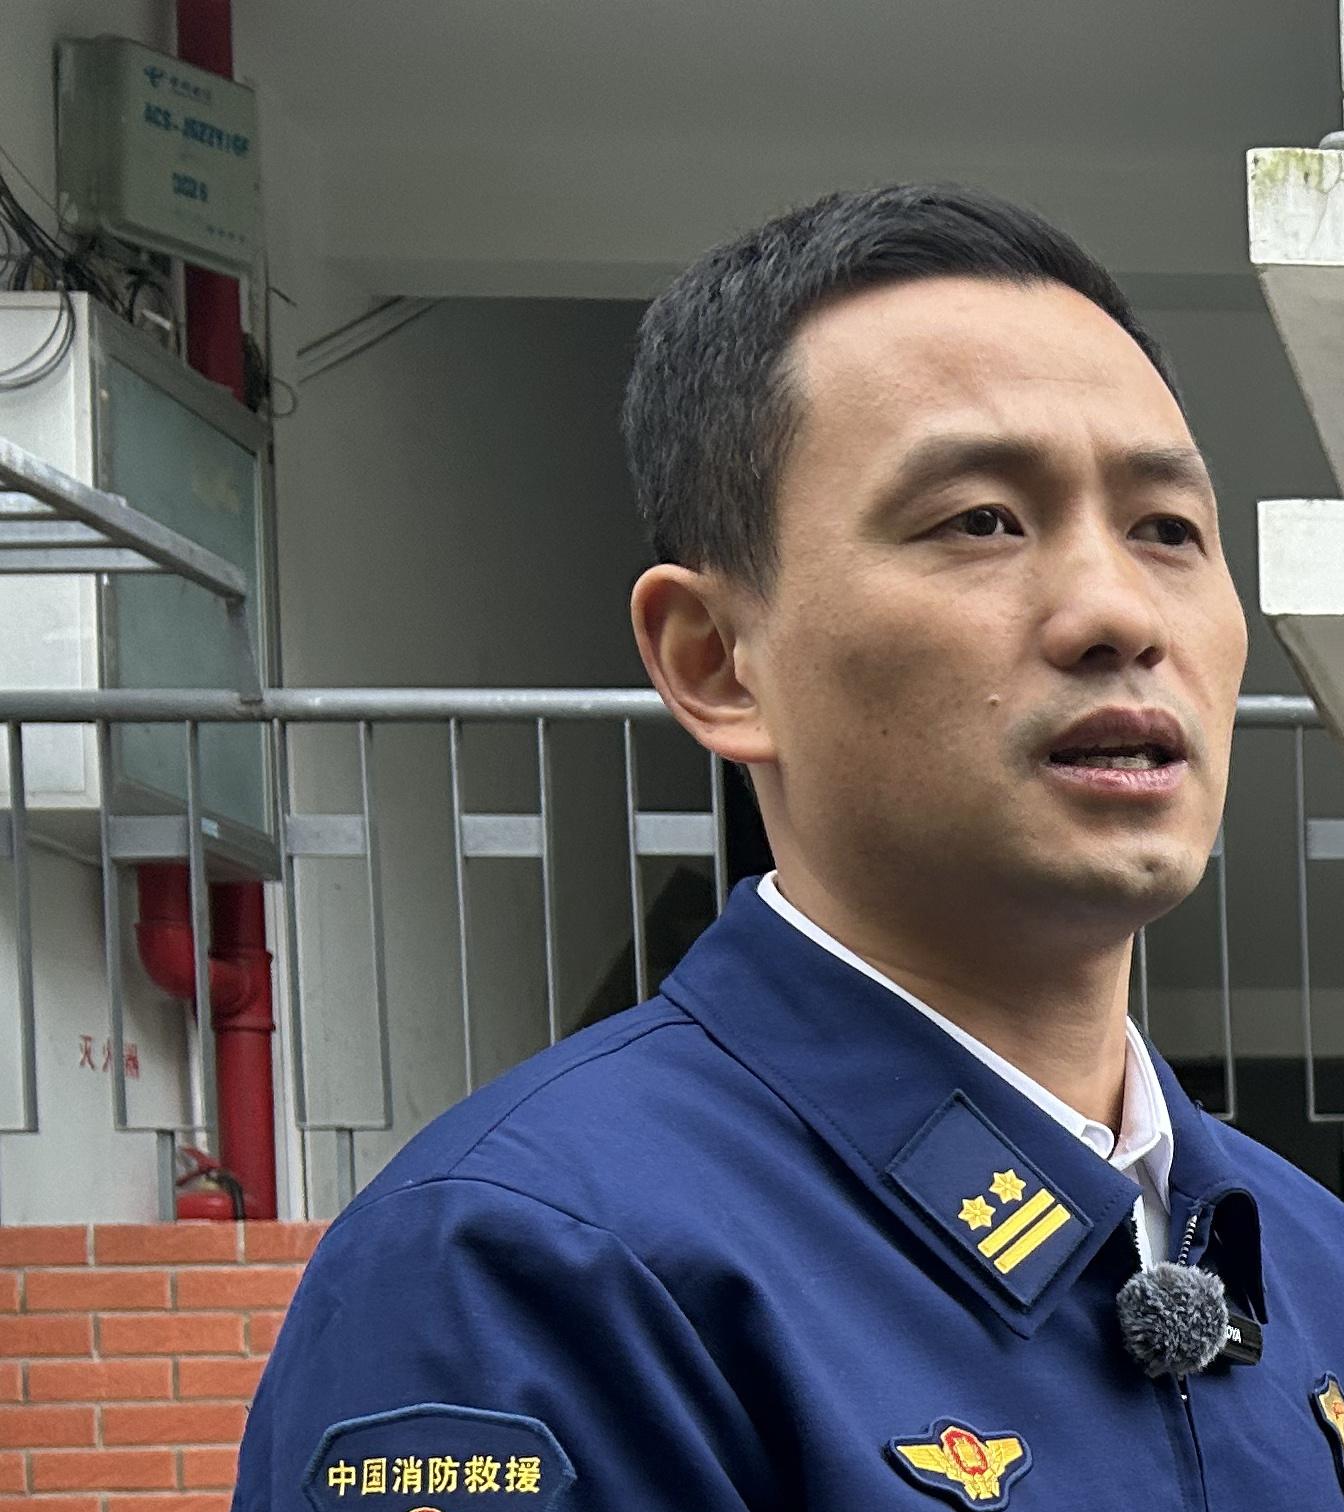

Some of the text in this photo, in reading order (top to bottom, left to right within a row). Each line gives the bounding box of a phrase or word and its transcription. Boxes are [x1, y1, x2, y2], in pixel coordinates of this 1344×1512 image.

[1225, 1325, 1242, 1344] OYA
[327, 1455, 542, 1497] 中国消防救援
